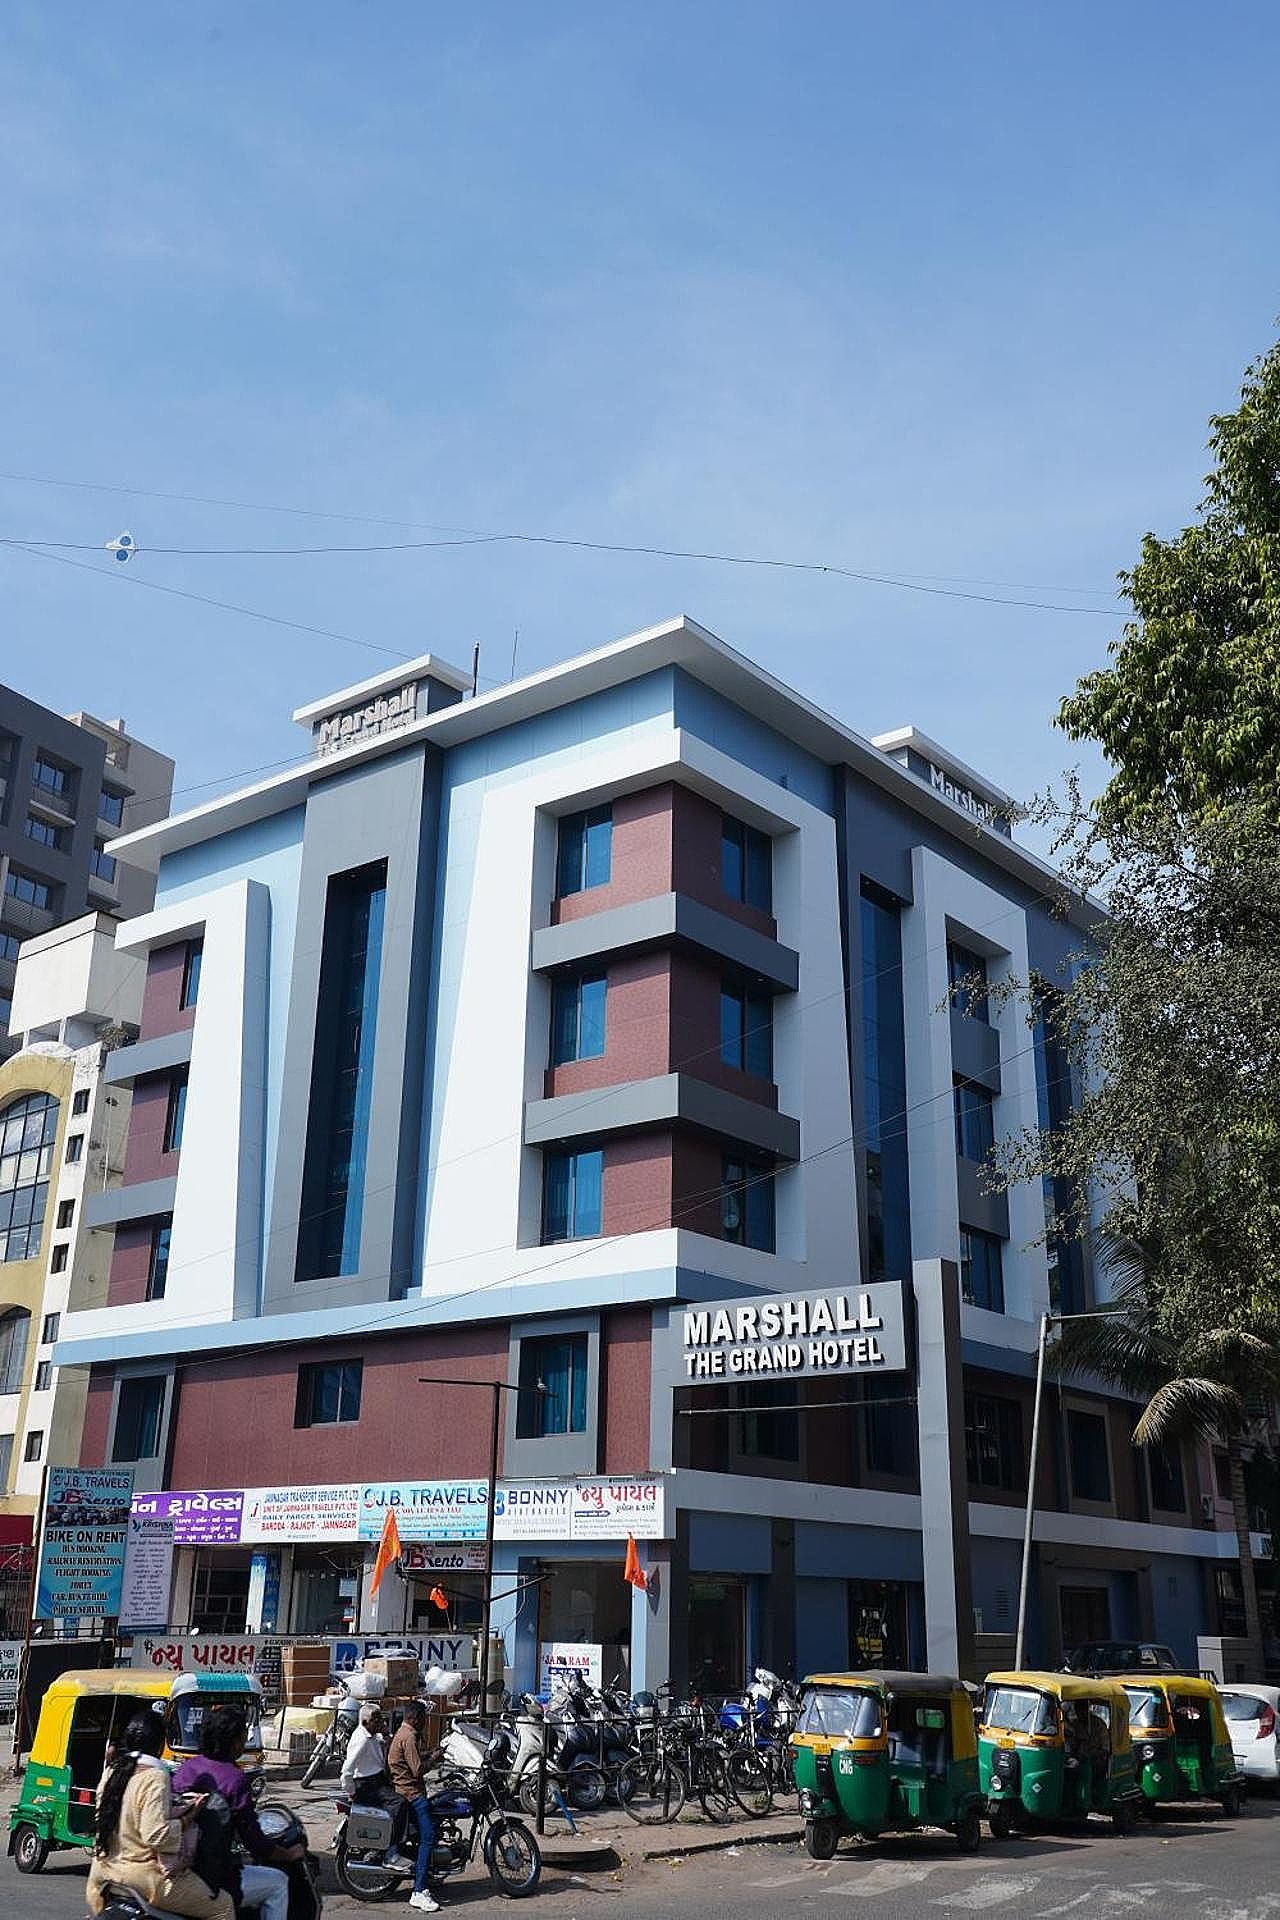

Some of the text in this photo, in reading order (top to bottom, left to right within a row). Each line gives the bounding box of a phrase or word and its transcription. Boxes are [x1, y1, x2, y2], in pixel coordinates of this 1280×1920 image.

[319, 681, 417, 743] Marshall
[683, 1293, 881, 1346] MARSHALL
[683, 1336, 883, 1377] THE GRAND HOTEL
[86, 1476, 130, 1489] TRAVELS
[410, 1486, 488, 1506] TRAVELS
[508, 1489, 568, 1505] BONNY
[609, 1485, 657, 1502] પાયલ
[320, 1519, 357, 1530] JAMNAGAR
[46, 1530, 126, 1543] BIKE ON RENT
[191, 1644, 256, 1666] પાયલ
